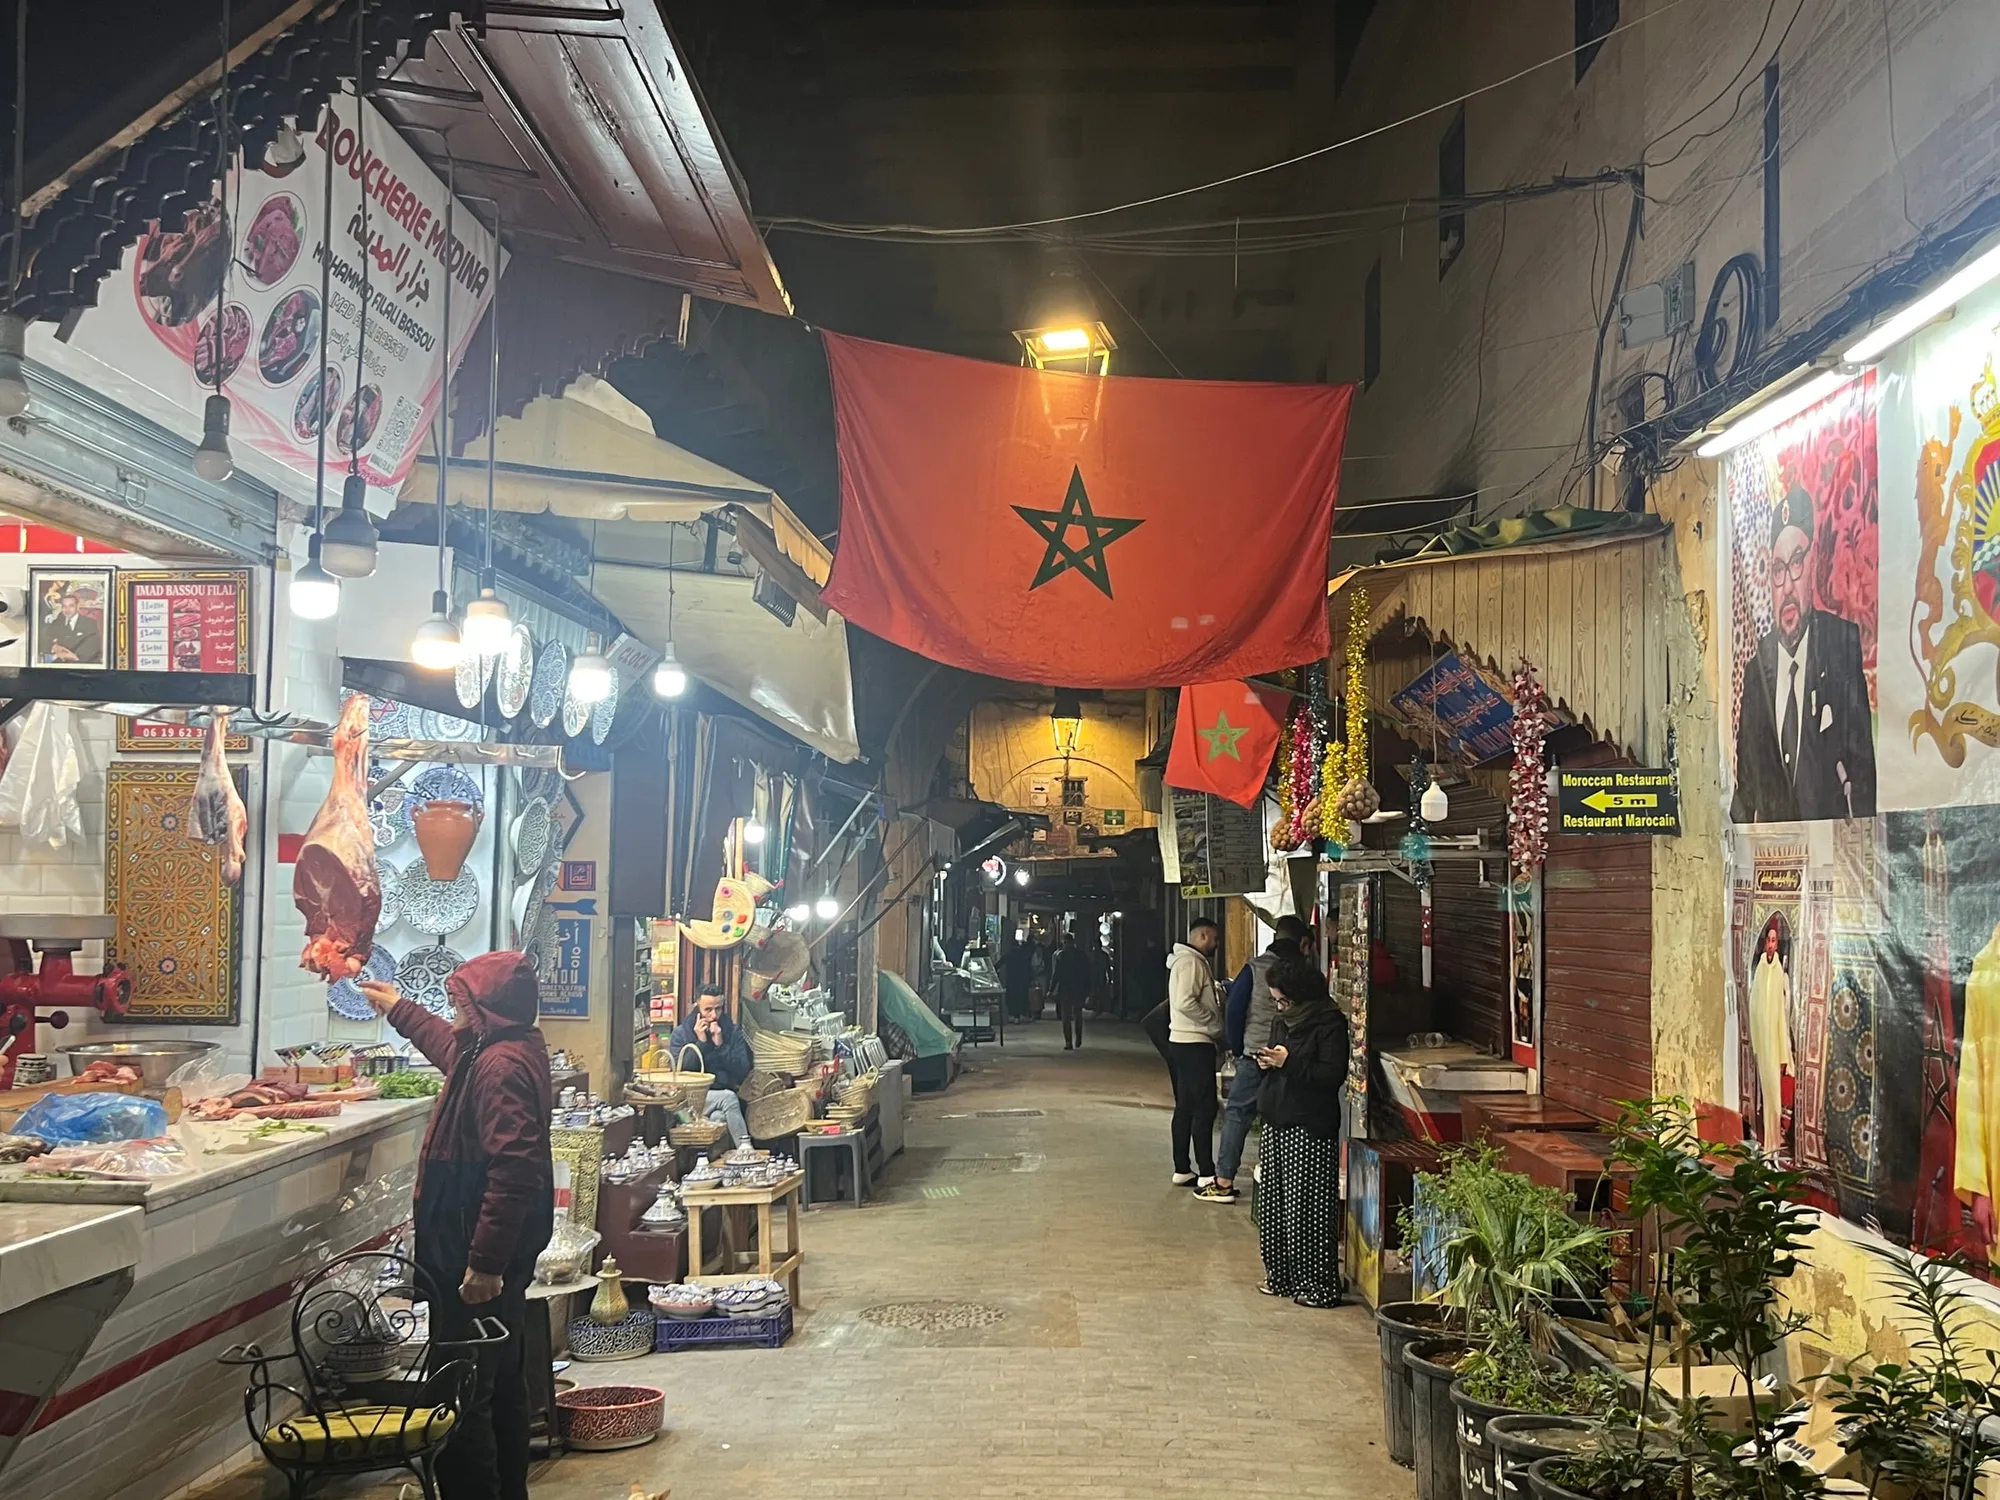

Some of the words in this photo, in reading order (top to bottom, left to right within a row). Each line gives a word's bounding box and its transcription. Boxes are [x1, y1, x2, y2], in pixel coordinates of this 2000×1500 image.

[315, 107, 432, 242] BOUCHERIE
[425, 219, 489, 299] MEDINA
[347, 203, 411, 278] المدينة
[329, 291, 356, 320] IMAD
[352, 310, 378, 338] FALI
[373, 327, 409, 361] BASSOU
[371, 292, 402, 326] FILALI
[398, 312, 436, 352] BASSOU
[136, 585, 164, 596] IMAD
[166, 585, 206, 596] BASSOU
[618, 647, 652, 669] CLOCK
[143, 728, 157, 737] 06
[161, 728, 174, 737] 19
[178, 728, 192, 737] 62
[1562, 774, 1613, 787] Moroccan
[1616, 773, 1673, 787] Restaurant
[1613, 796, 1624, 806] 5
[1563, 814, 1623, 828] Restaurant
[1625, 813, 1676, 827] Marocain
